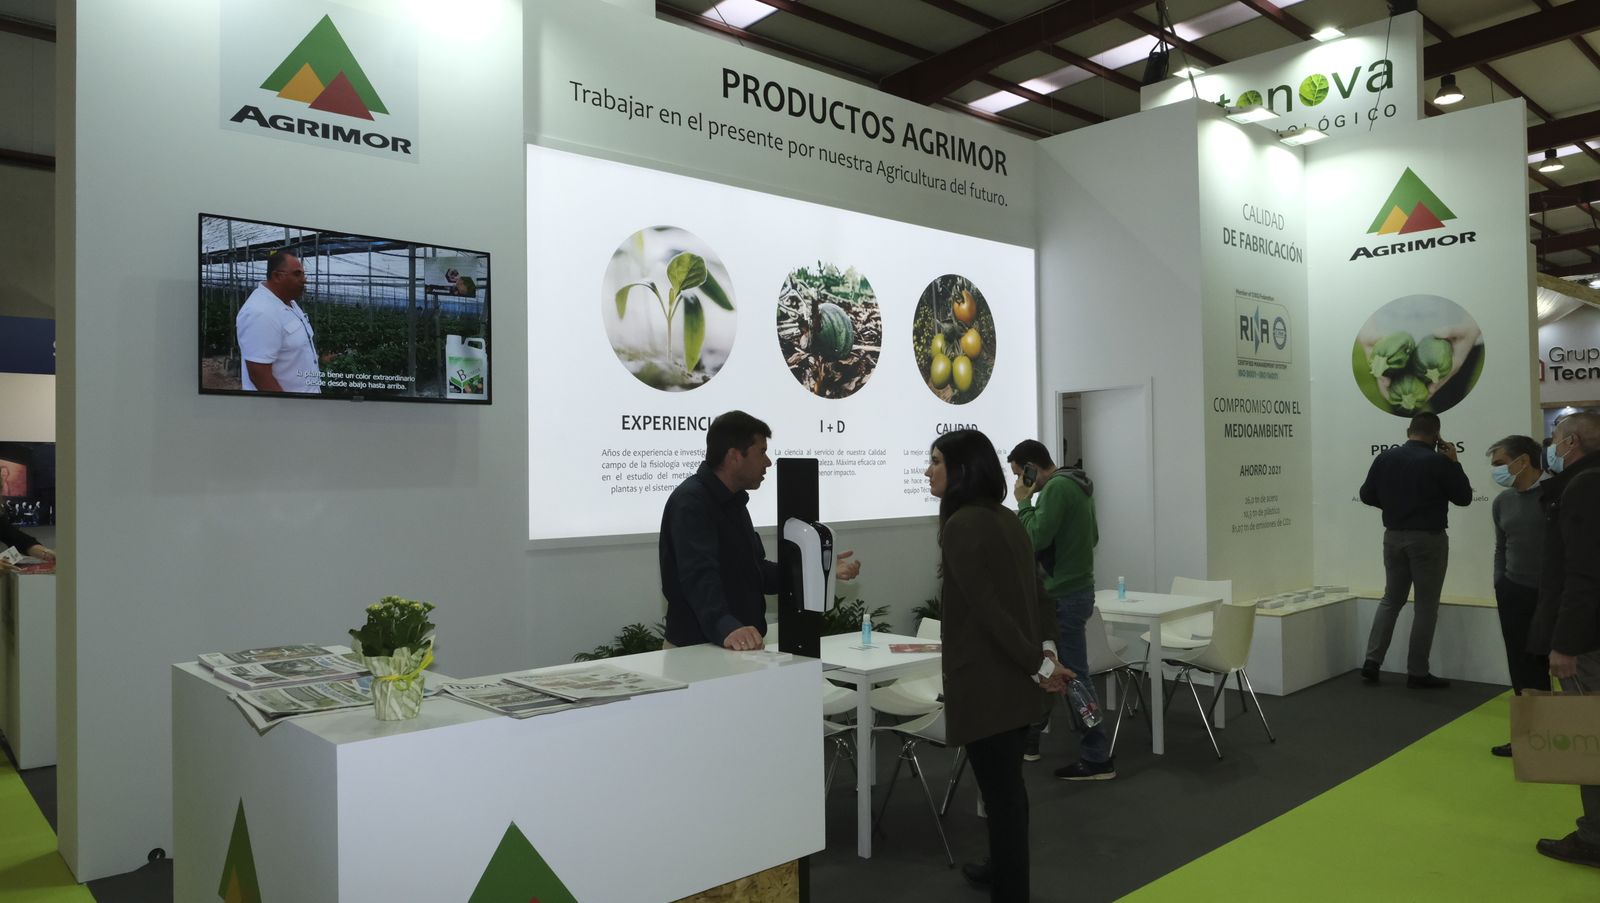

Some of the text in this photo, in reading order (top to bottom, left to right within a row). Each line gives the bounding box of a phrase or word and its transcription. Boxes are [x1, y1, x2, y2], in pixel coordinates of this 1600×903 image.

[229, 104, 412, 155] AGRIMOR
[722, 67, 1008, 177] PRODUCTOS AGRIMOR
[569, 80, 1008, 207] Trabajar en el presente por nuestra Agricultura del futuro.
[1242, 203, 1285, 231] CALIDAD
[1223, 226, 1303, 264] DE FABRICACIÓN
[1349, 231, 1477, 261] AGRIMOR
[327, 370, 344, 378] tiene
[356, 372, 371, 380] color
[372, 374, 416, 382] extraordinario
[328, 380, 348, 388] desde
[348, 380, 367, 389] abajo
[1213, 397, 1301, 414] COMPROMISO CON EL
[621, 415, 712, 431] EXPERIENCI
[837, 420, 845, 433] D
[1224, 423, 1294, 438] MEDIOAMBIENTE
[601, 448, 620, 457] Años
[622, 448, 632, 457] de
[633, 448, 672, 458] experiencia
[680, 448, 707, 458] investig
[601, 461, 626, 471] campo
[629, 460, 638, 469] de
[640, 460, 647, 469] la
[1240, 464, 1281, 476] AHORRO 2021
[601, 474, 612, 482] en
[616, 472, 623, 481] el
[626, 472, 654, 480] estudio
[657, 471, 668, 480] del
[610, 484, 638, 495] plantas
[638, 486, 644, 494] y
[644, 484, 651, 492] el
